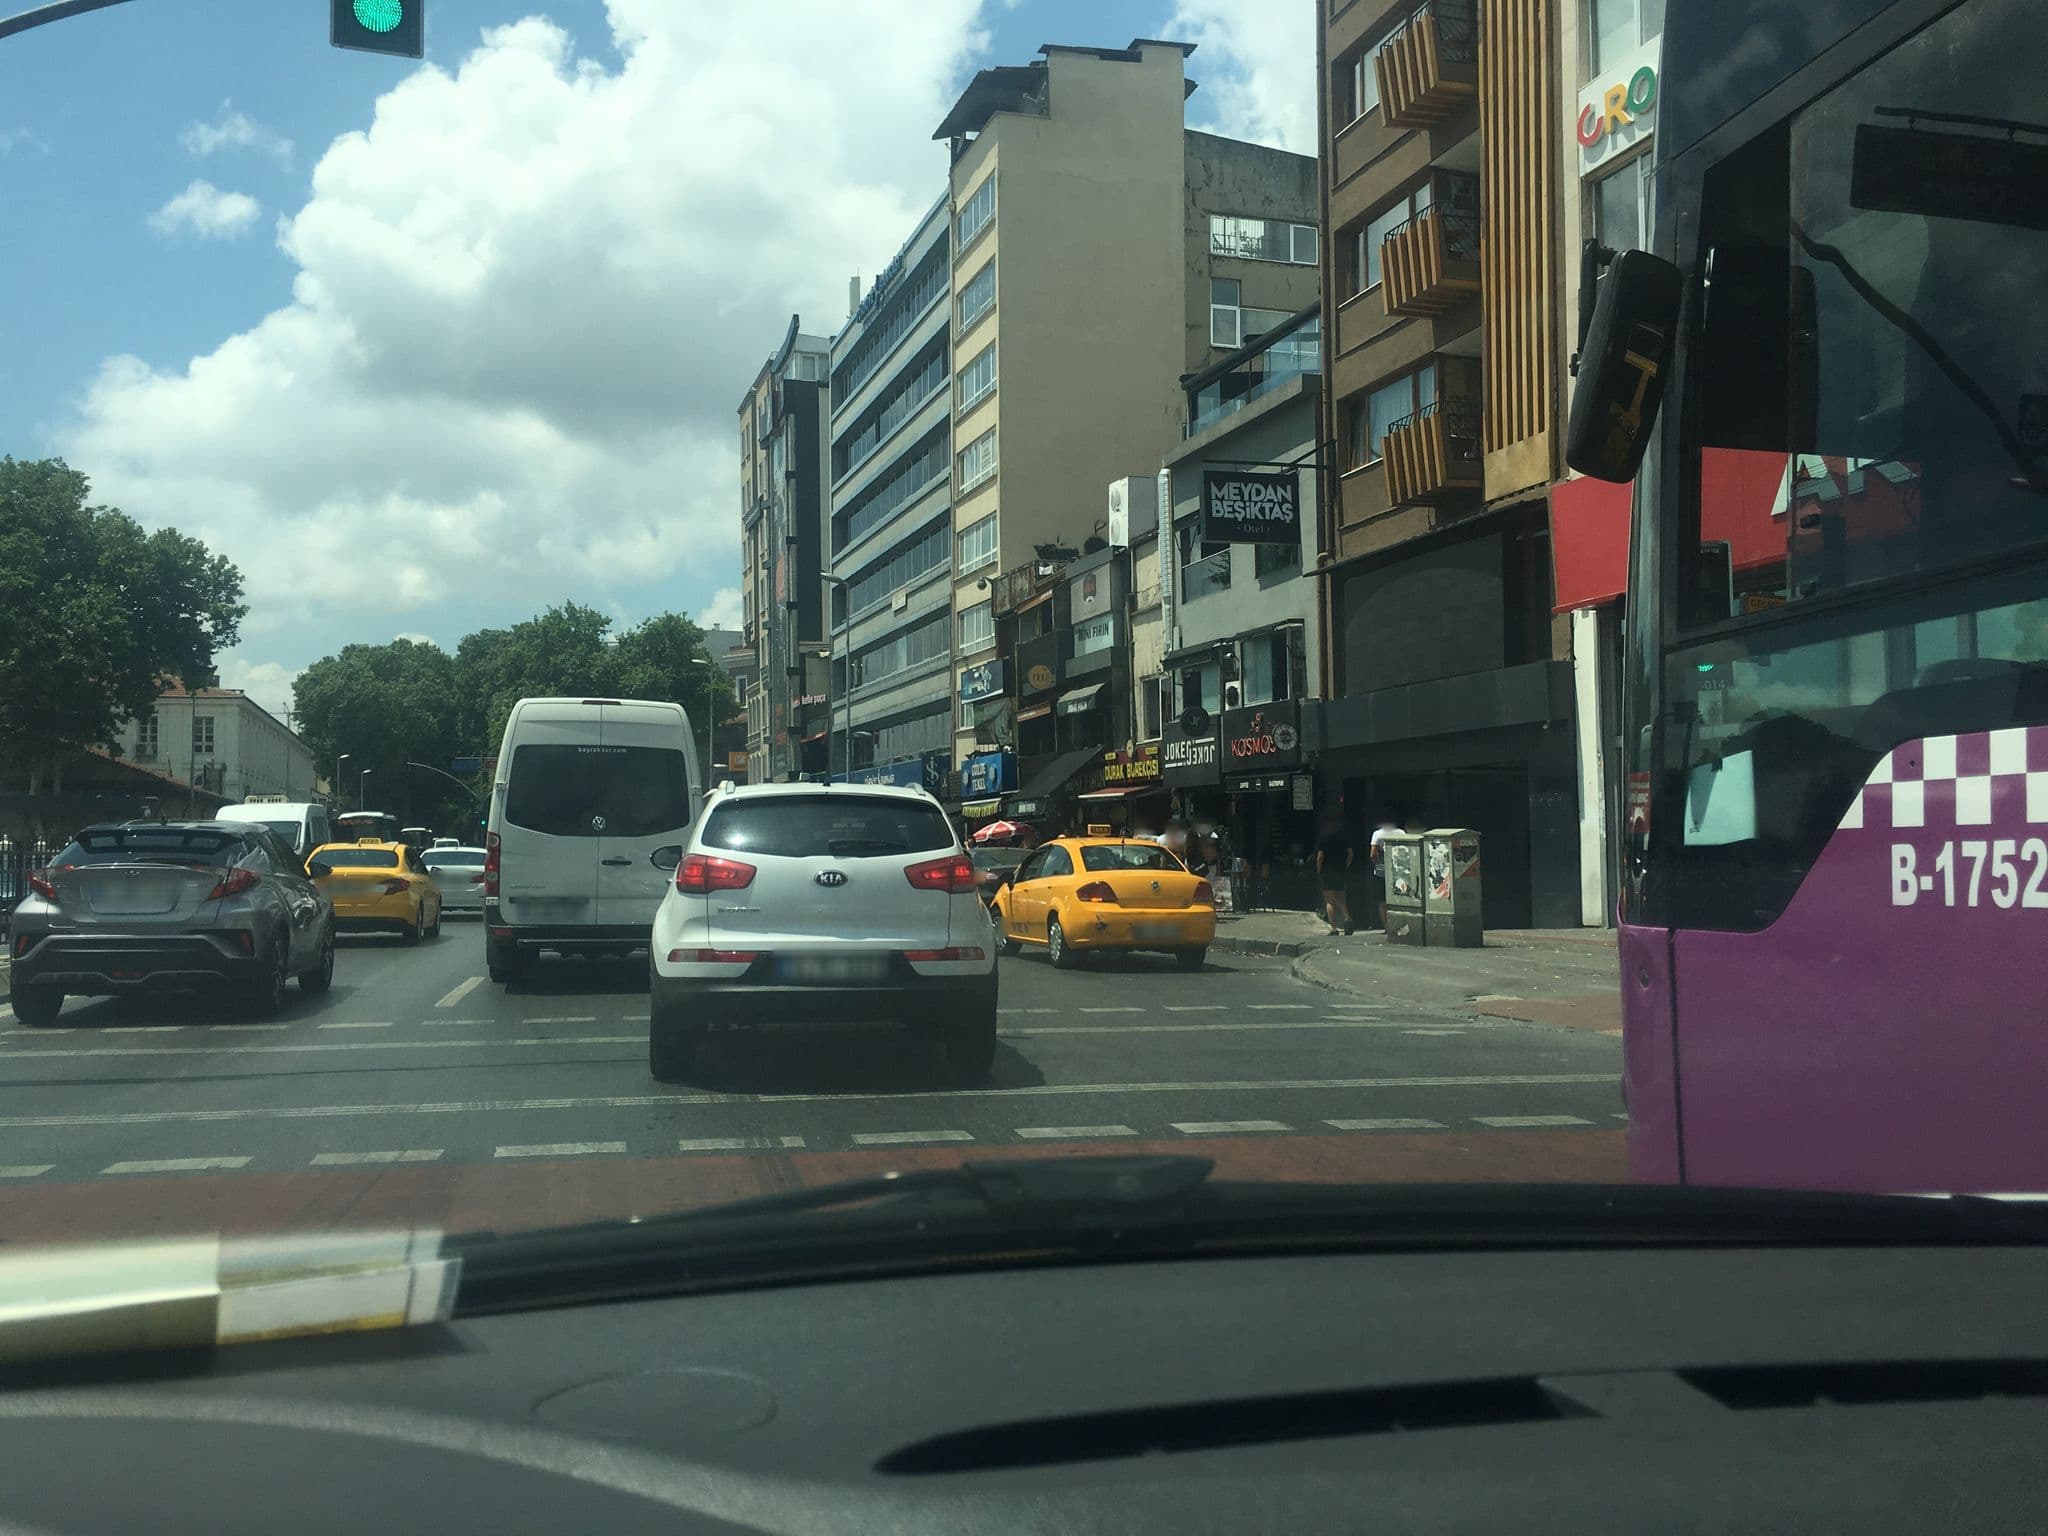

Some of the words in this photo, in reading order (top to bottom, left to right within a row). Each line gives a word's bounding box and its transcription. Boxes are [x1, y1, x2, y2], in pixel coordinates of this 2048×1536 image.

[1577, 66, 1657, 147] CRO
[1210, 481, 1292, 503] MEYDAN
[1211, 500, 1294, 523] BEŞİKTAŞ
[1243, 524, 1265, 534] Otel
[819, 872, 843, 884] KIA
[1891, 838, 2048, 909] B-1752
